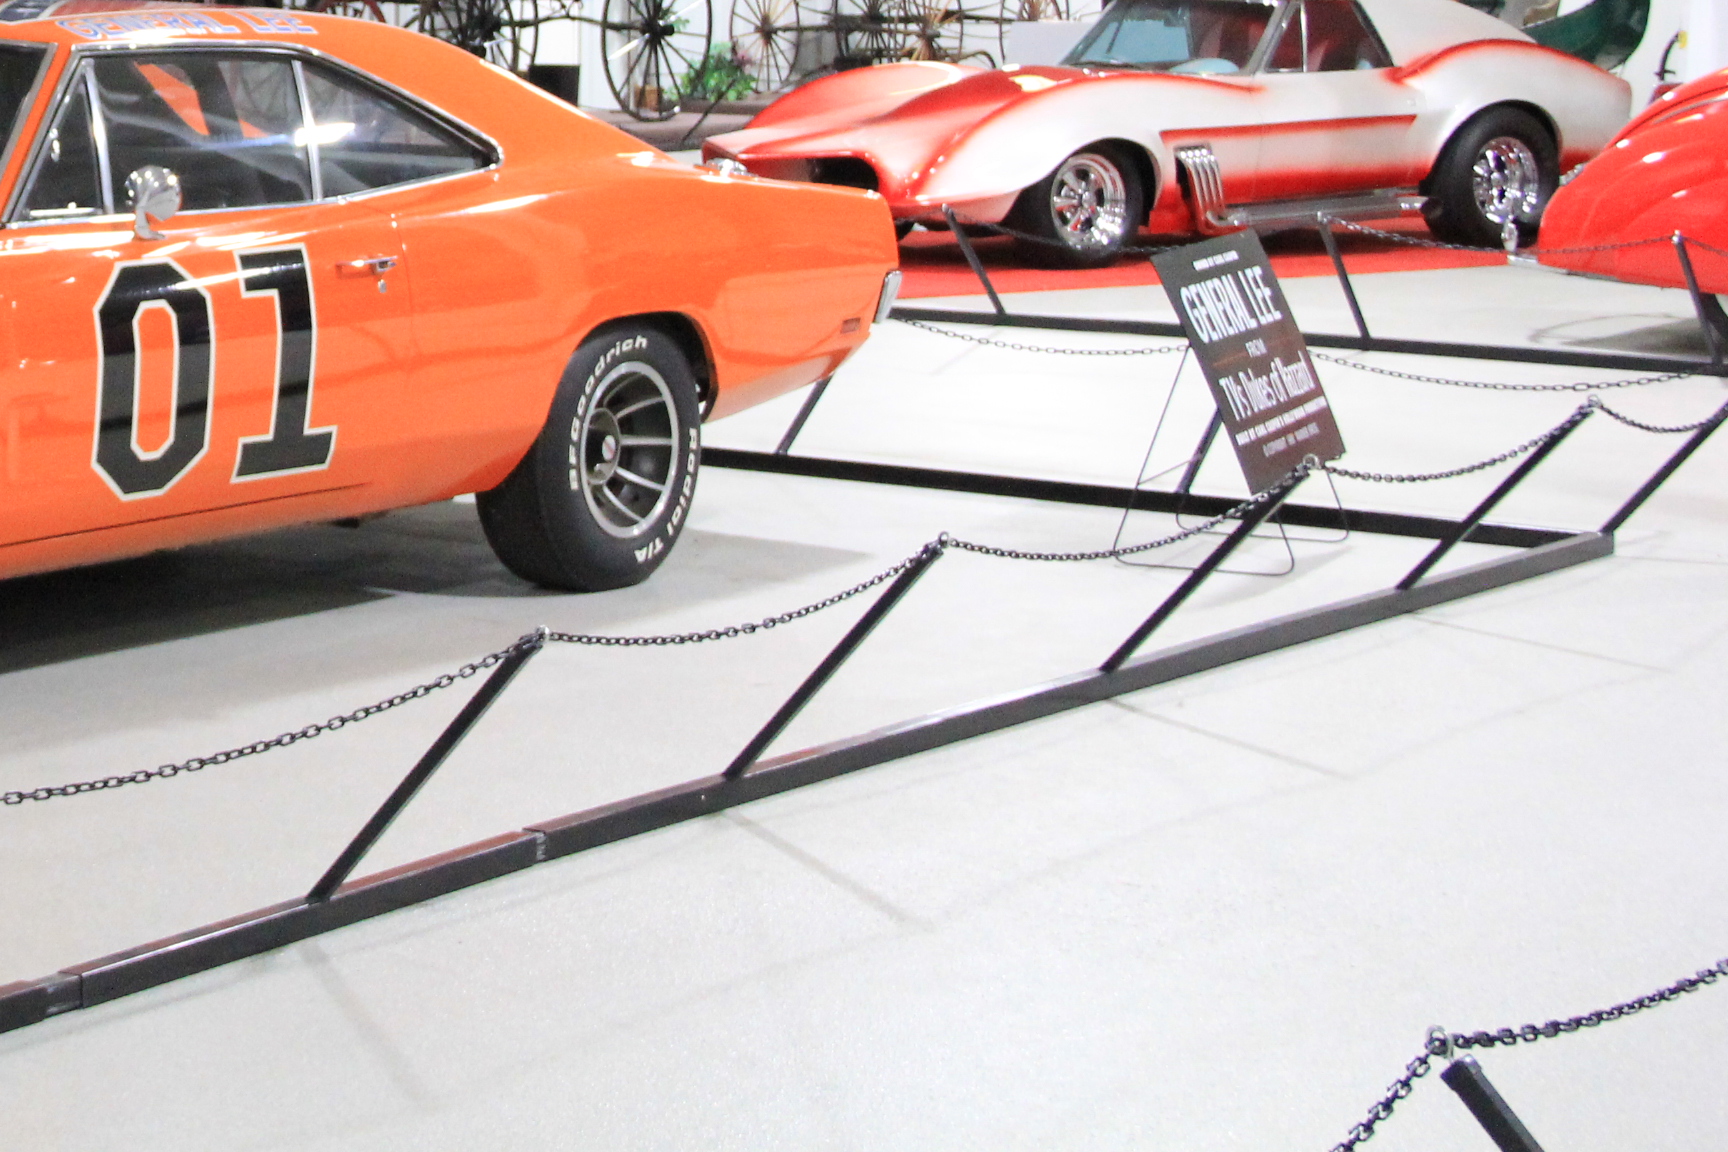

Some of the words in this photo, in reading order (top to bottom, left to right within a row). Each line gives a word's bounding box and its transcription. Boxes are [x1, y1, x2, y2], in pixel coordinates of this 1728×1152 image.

[55, 9, 241, 40] GENERAL
[224, 9, 319, 35] LEE
[1180, 273, 1258, 344] GENERAL
[1237, 265, 1283, 325] LEE
[90, 242, 338, 501] 01
[1238, 367, 1277, 413] Dukes
[568, 334, 647, 491] BFGoodrich
[667, 427, 698, 537] Radial
[634, 540, 665, 564] T/A
